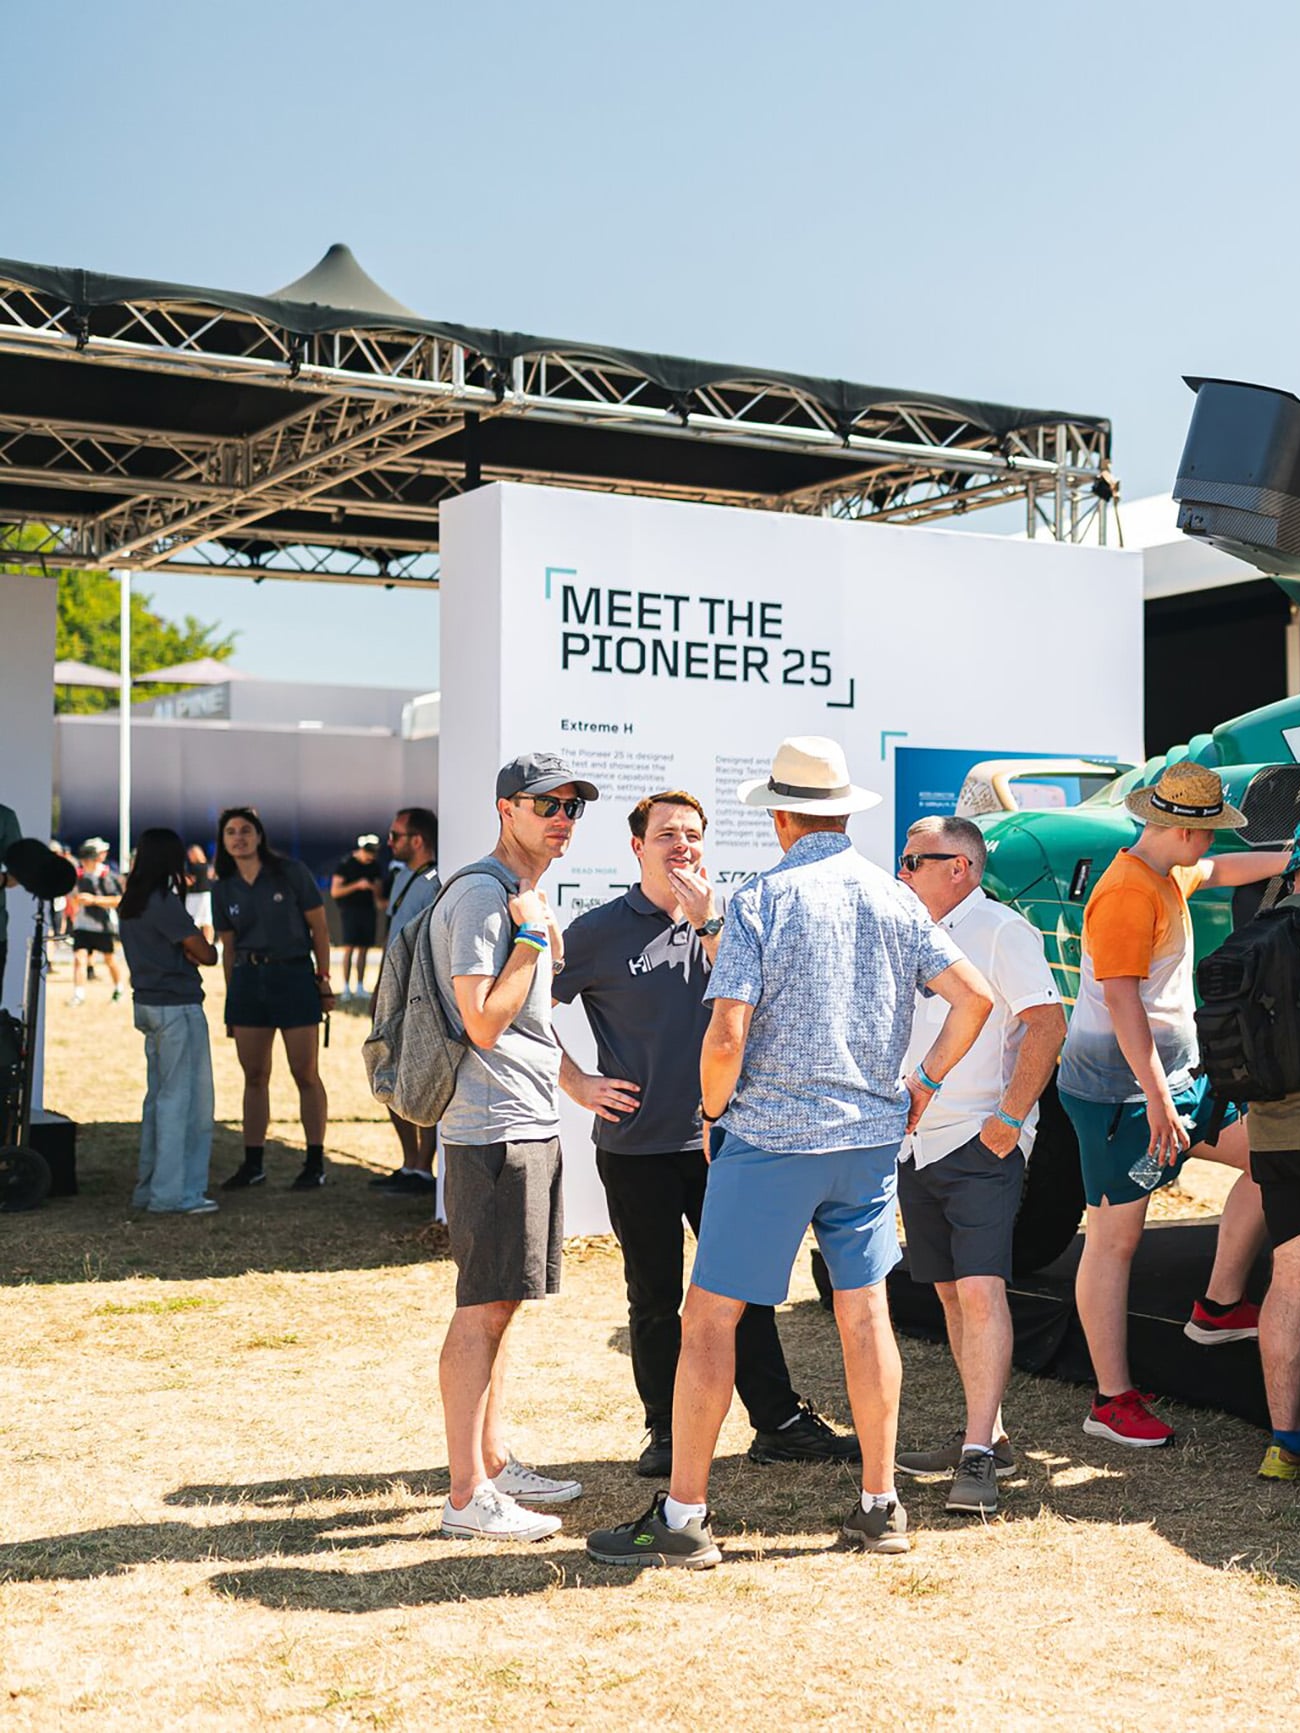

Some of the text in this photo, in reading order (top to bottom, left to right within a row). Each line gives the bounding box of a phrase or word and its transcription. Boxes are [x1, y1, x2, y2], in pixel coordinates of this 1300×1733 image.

[561, 585, 783, 640] MEET THE
[561, 632, 832, 687] PIONEER 25
[560, 719, 634, 734] Extreme H
[579, 749, 611, 758] Pioneer
[613, 751, 625, 760] 25
[635, 752, 675, 762] designed
[609, 762, 649, 771] showcase
